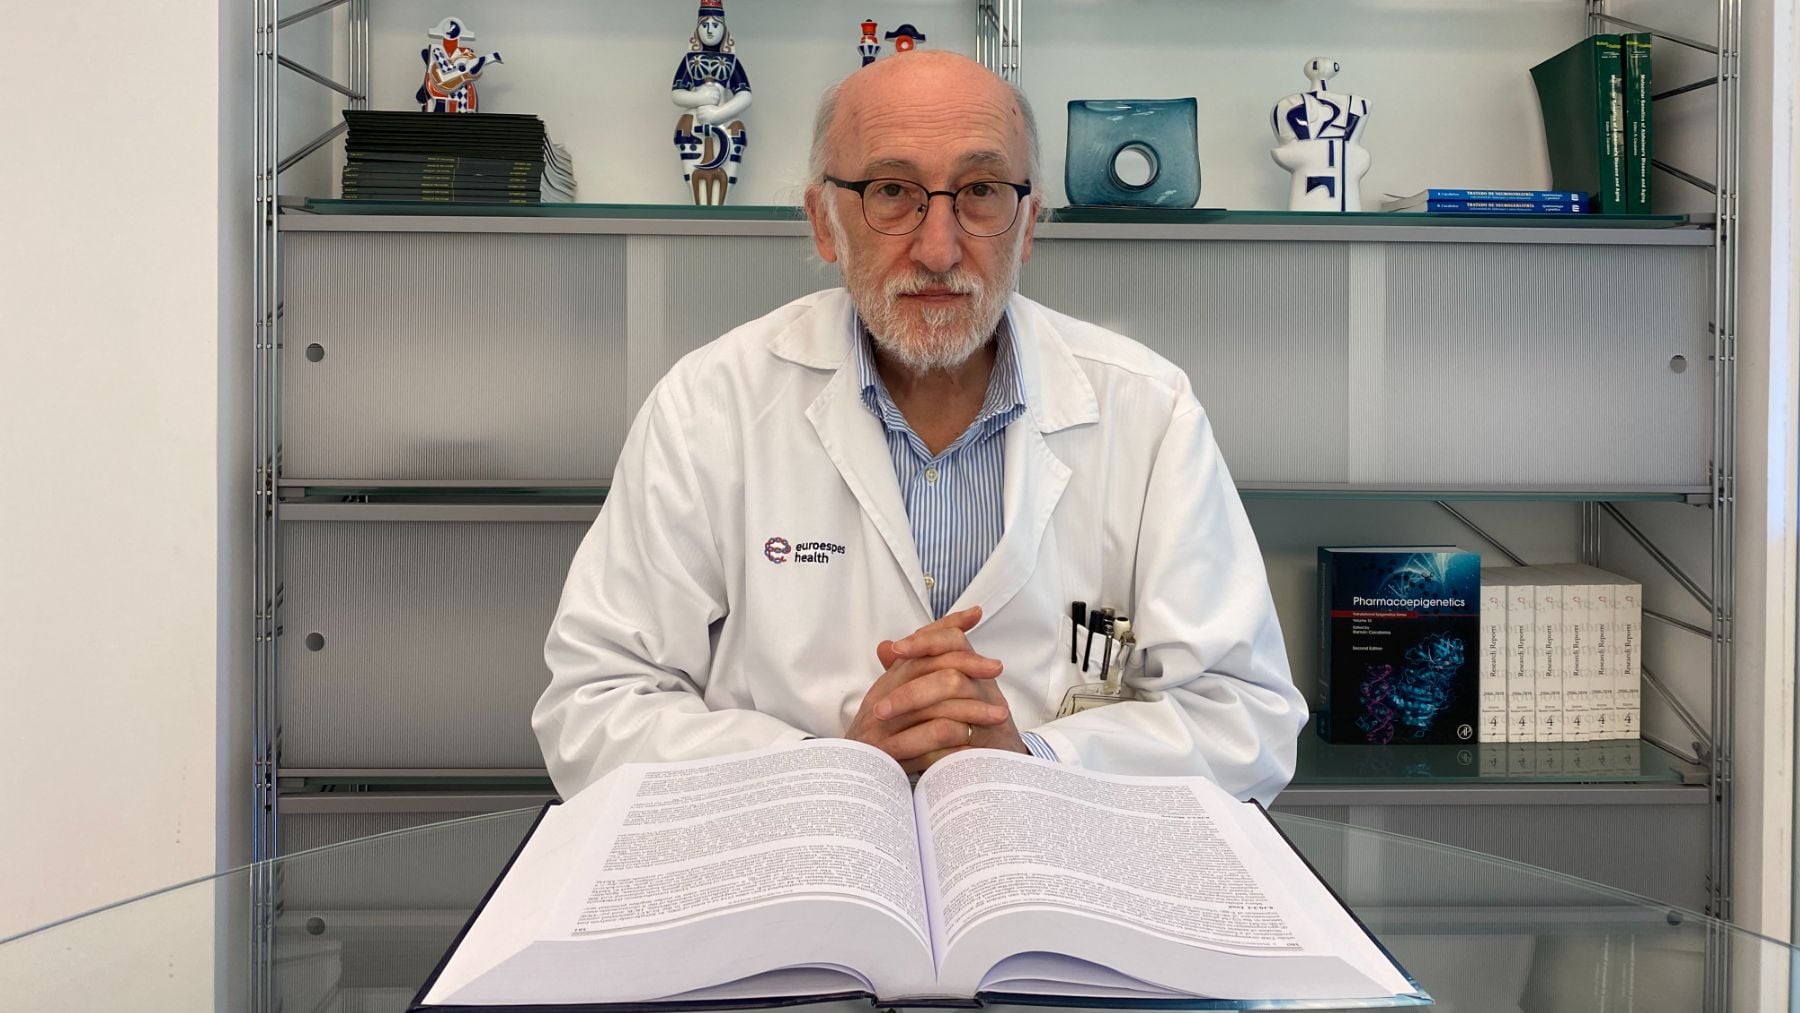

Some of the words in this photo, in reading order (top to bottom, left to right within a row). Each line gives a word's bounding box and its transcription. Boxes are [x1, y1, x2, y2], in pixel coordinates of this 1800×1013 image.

[794, 551, 829, 563] health
[795, 541, 846, 554] euroespes
[1352, 596, 1466, 609] Pharmacoepigenetics
[1490, 625, 1498, 649] Reports
[1518, 625, 1526, 649] Reports
[1546, 625, 1554, 648] Reports
[1573, 624, 1581, 648] Reports
[1598, 624, 1606, 647] Reports
[1624, 623, 1633, 646] Reports
